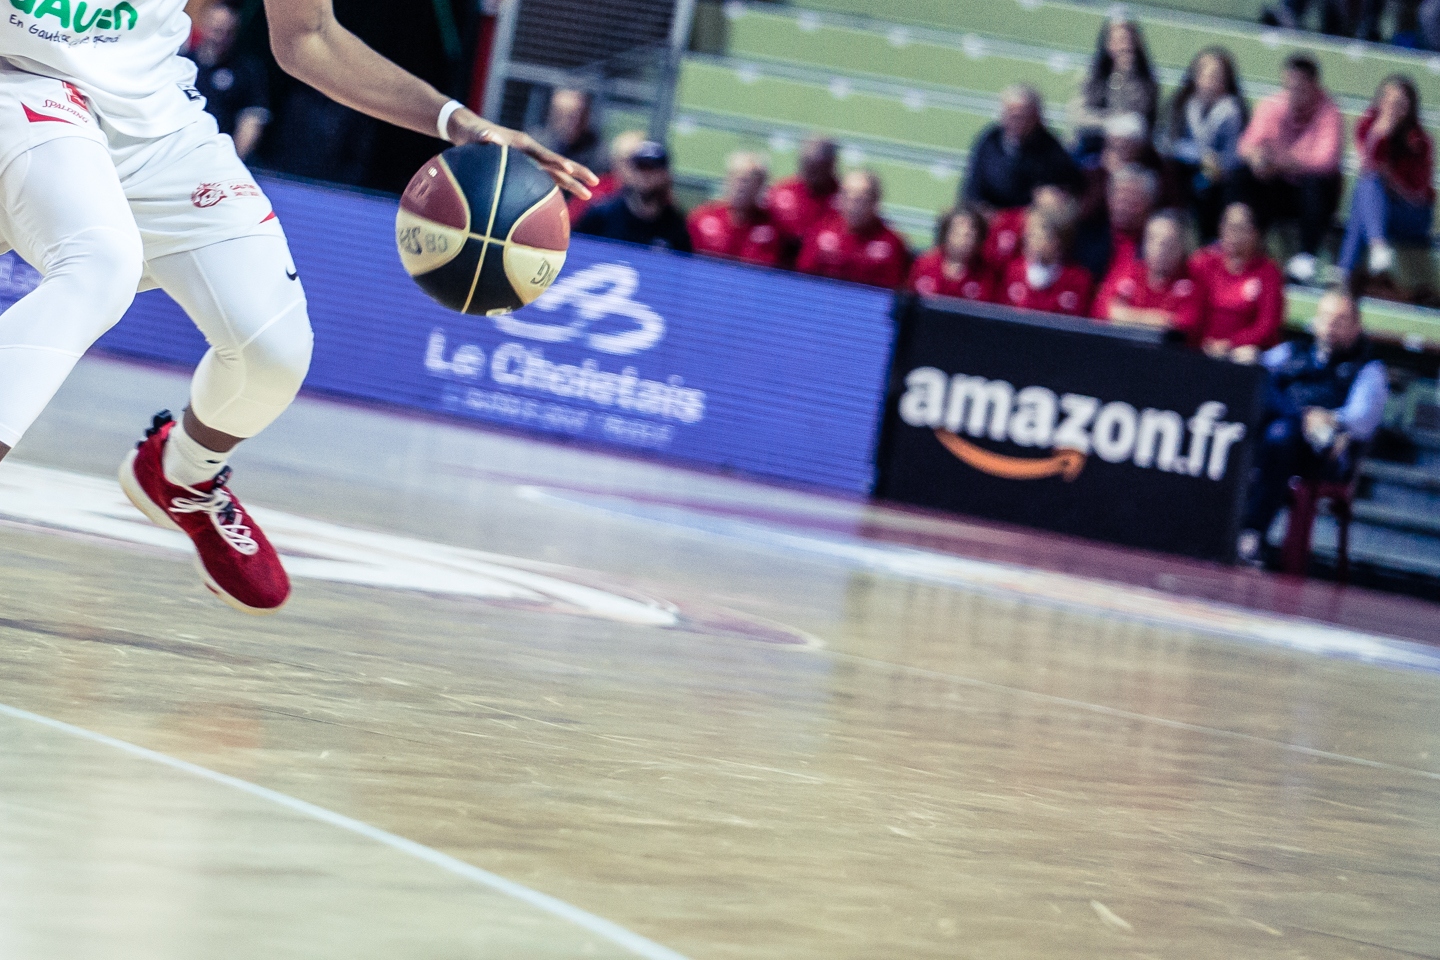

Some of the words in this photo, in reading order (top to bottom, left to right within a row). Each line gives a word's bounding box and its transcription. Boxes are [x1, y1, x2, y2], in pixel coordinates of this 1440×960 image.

[9, 13, 24, 29] En
[42, 99, 90, 124] SPALDING
[424, 328, 487, 378] Le
[490, 342, 707, 424] Choletais
[898, 365, 1247, 482] amazon.fr
